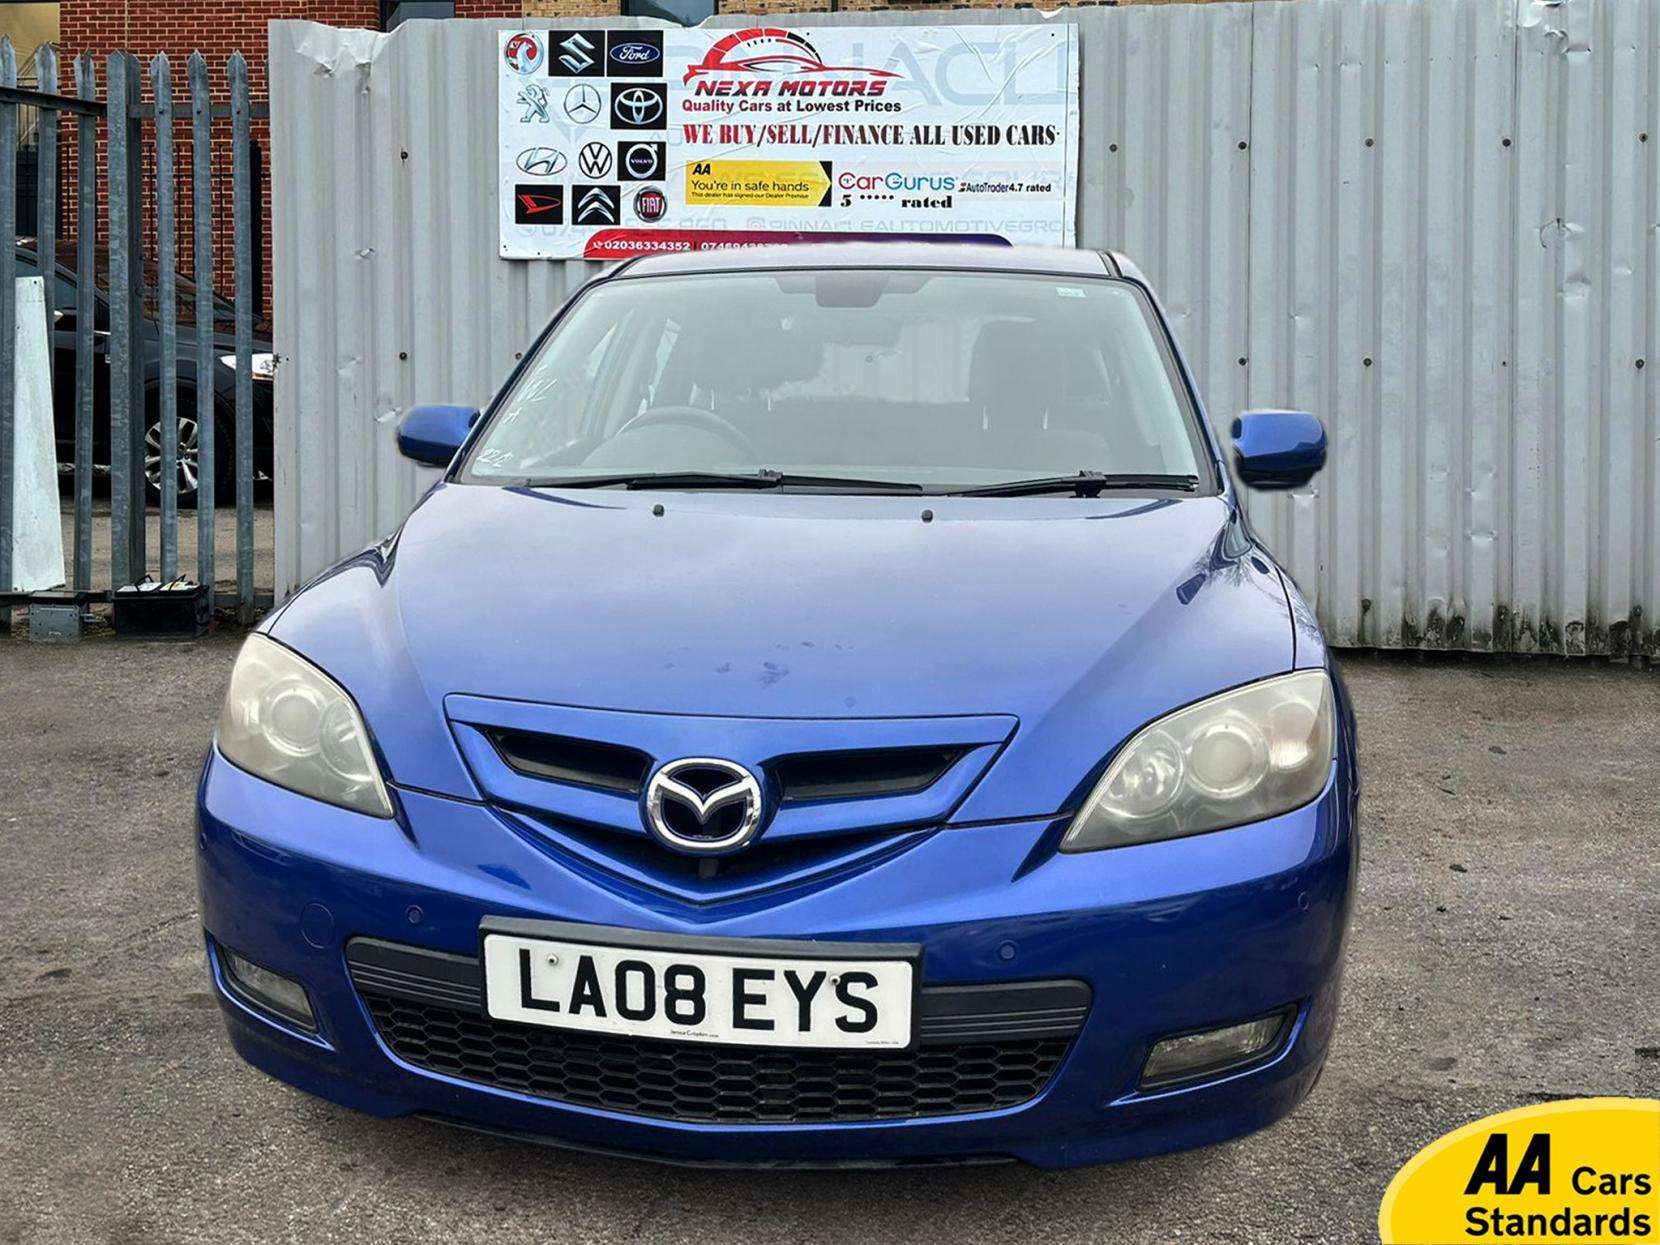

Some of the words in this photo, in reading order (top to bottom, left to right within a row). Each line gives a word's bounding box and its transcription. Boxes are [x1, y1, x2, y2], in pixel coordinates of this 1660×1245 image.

[619, 46, 650, 60] Ford
[695, 80, 773, 96] NEXA
[778, 80, 887, 97] MOTORS
[682, 99, 734, 114] Quality
[739, 99, 772, 112] Cars
[777, 101, 792, 112] at
[796, 100, 850, 112] Lowest
[855, 100, 901, 112] Prices
[683, 124, 713, 144] WE
[719, 124, 903, 148] BUY/SELL/FINANCE
[909, 124, 946, 145] ALL
[952, 125, 1000, 145] USED
[1006, 125, 1056, 145] CARS
[692, 163, 711, 175] AA
[691, 180, 728, 191] You're
[731, 180, 742, 191] in
[744, 180, 770, 192] safe
[772, 180, 809, 192] hands
[838, 172, 955, 191] CarGurus
[1026, 183, 1051, 192] rated
[642, 197, 660, 213] FIAT
[840, 194, 852, 207] 5
[901, 195, 952, 208] rated
[604, 241, 691, 251] 02036334352
[519, 948, 706, 1026] LA08
[732, 967, 878, 1033] EYS
